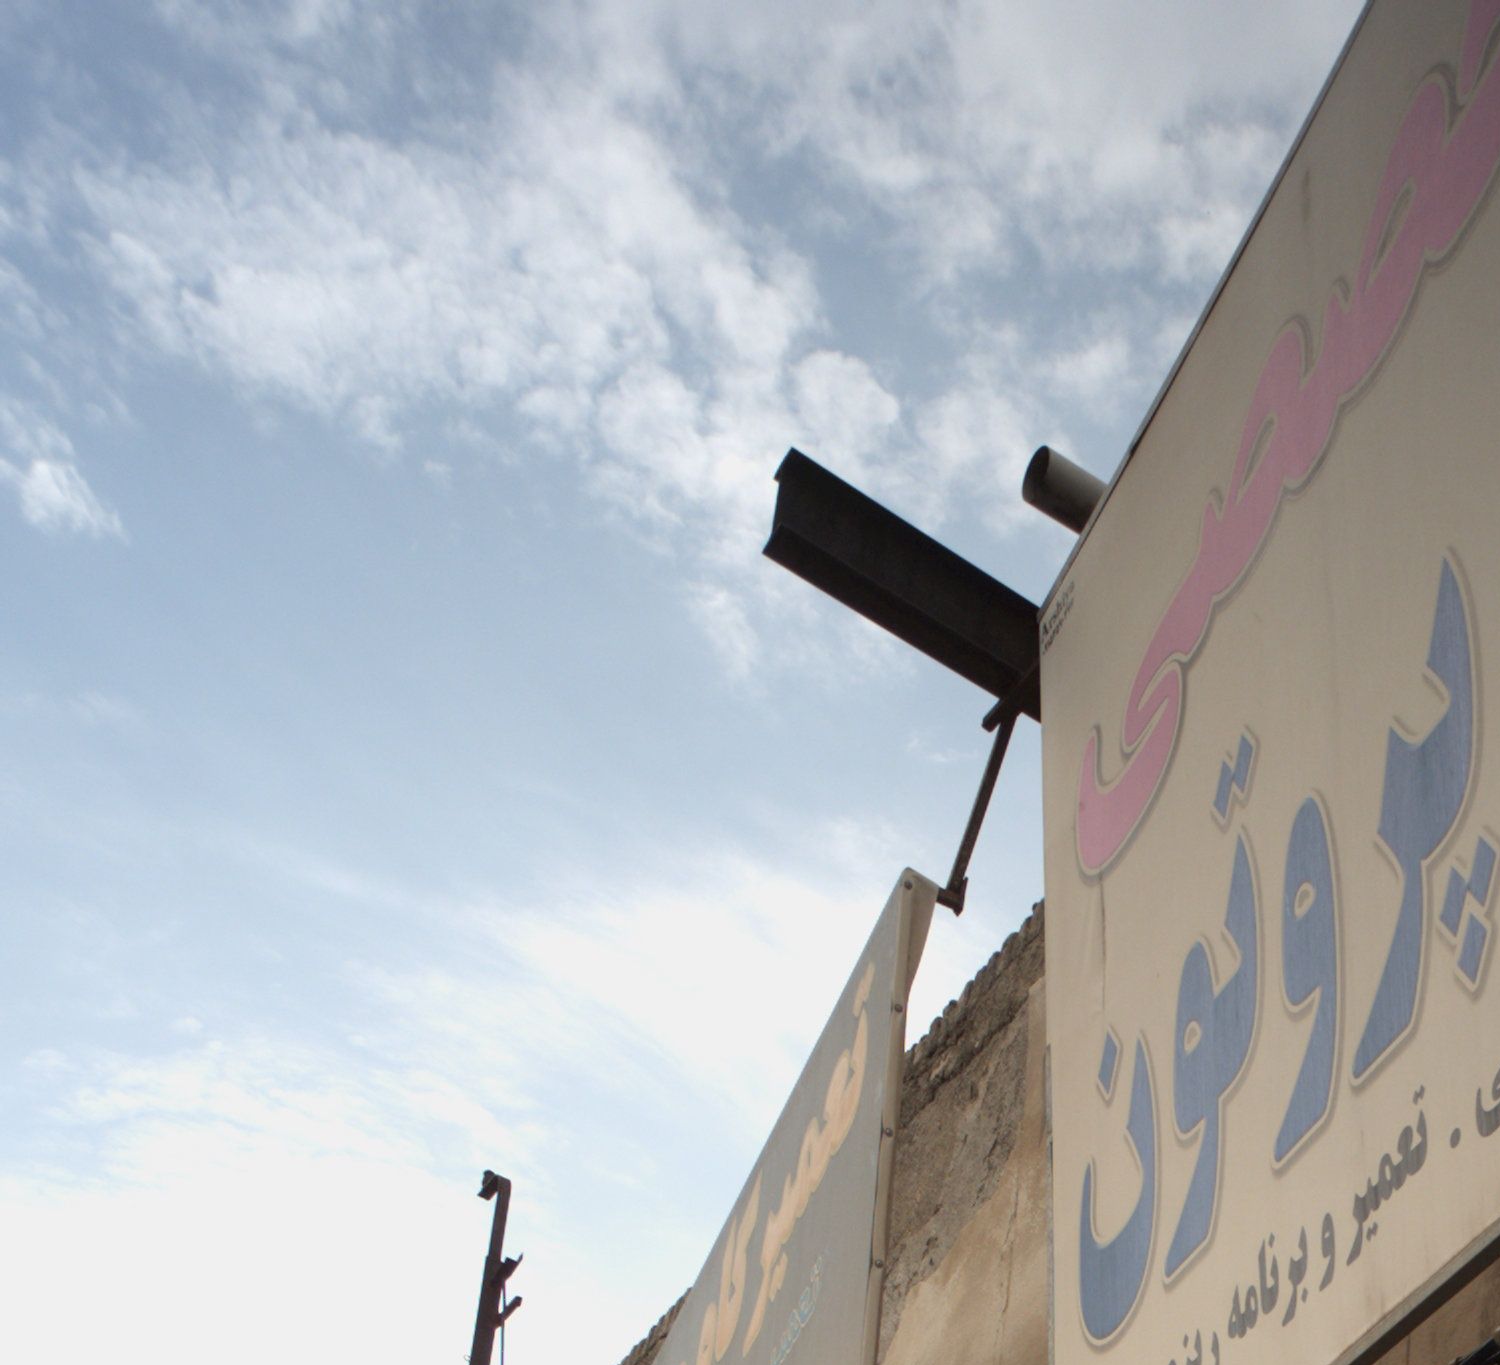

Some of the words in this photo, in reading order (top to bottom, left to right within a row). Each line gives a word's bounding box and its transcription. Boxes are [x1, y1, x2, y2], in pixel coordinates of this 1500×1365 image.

[1079, 556, 1497, 1344] پروتون
[1346, 1086, 1429, 1265] تعمیر
[1227, 1229, 1309, 1340] برنامه
